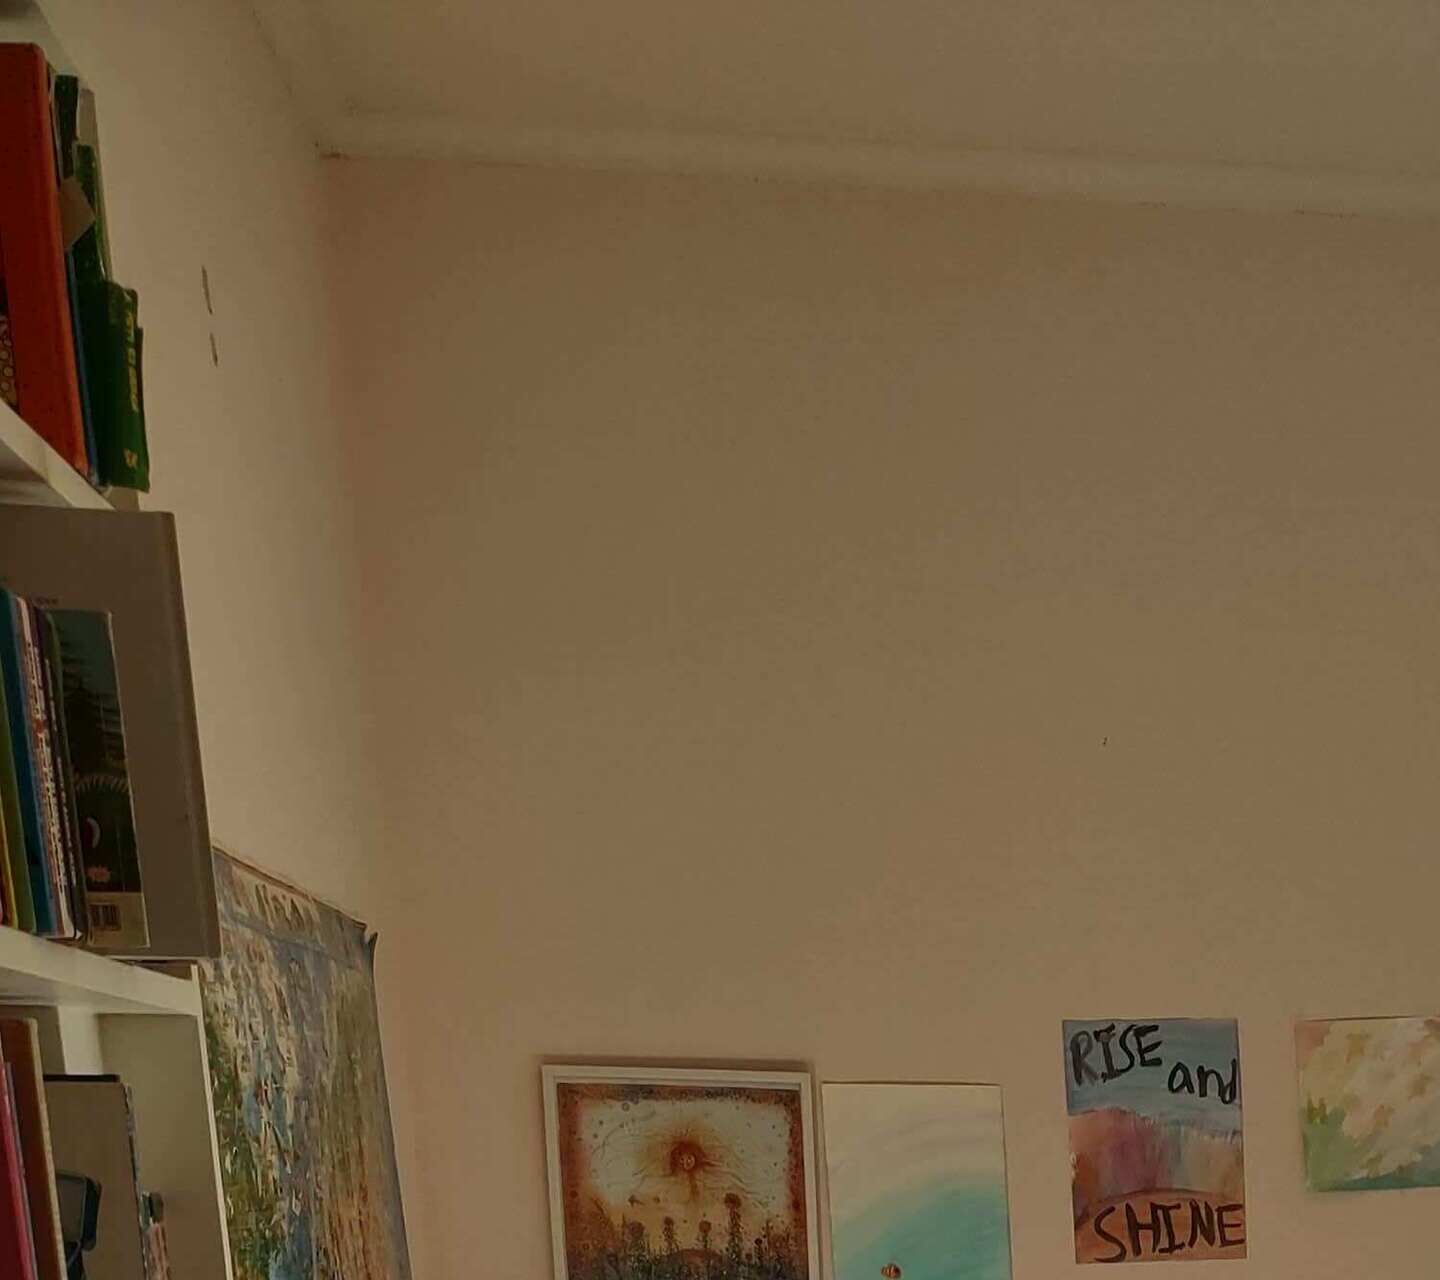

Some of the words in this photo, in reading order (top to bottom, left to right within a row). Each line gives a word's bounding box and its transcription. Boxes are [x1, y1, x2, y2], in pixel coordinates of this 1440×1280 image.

[1069, 1023, 1163, 1086] RISE
[1167, 1059, 1237, 1104] and
[1093, 1200, 1246, 1263] SHINE
